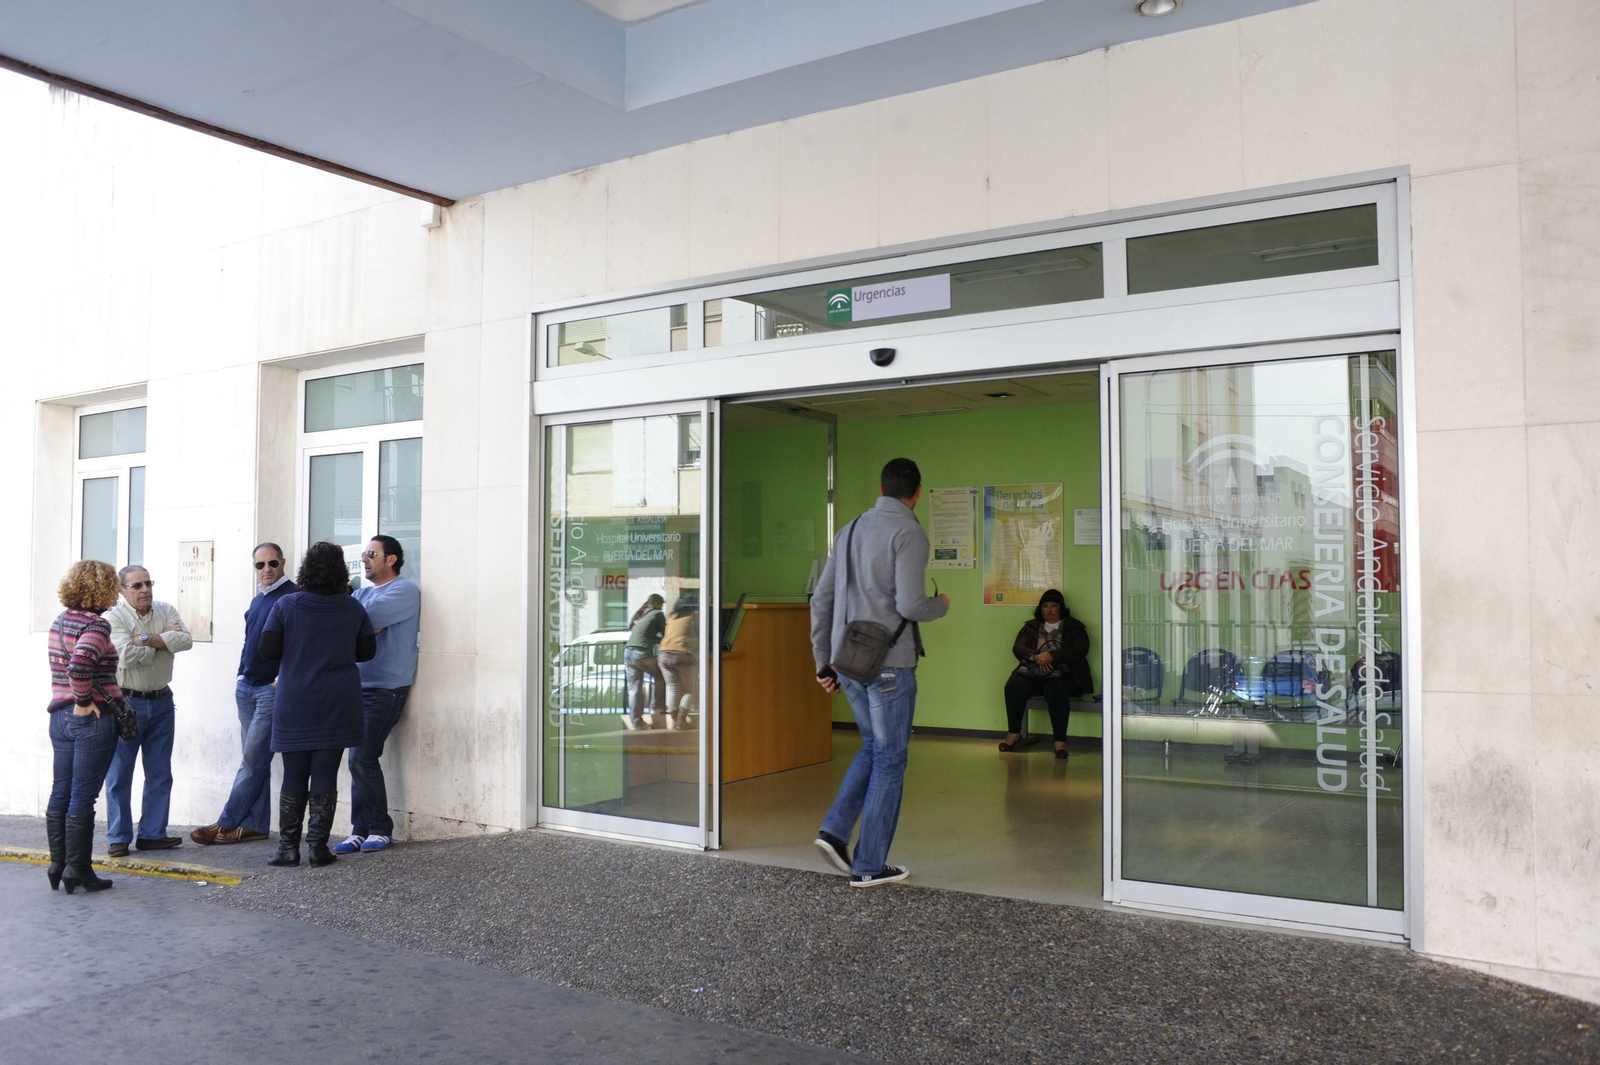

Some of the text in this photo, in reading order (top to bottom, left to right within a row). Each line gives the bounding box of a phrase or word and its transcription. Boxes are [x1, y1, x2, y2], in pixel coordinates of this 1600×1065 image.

[854, 286, 906, 303] Urgencias
[1354, 415, 1386, 523] Servicio
[996, 490, 1043, 500] Derechos
[1161, 511, 1306, 532] Hospital Universitario
[596, 531, 682, 546] Hospital Universitario
[1174, 536, 1294, 553] PUERTA DEL MAR
[192, 545, 199, 560] 9
[603, 550, 633, 561] PUERTA
[636, 549, 652, 560] DEL
[654, 549, 674, 560] MAR
[1159, 569, 1312, 591] URGENCIAS
[1312, 413, 1348, 792] CONSEJERIA DE SALUD
[1356, 532, 1390, 654] Andaluz
[1358, 661, 1391, 700] de
[1359, 712, 1392, 791] Salud
